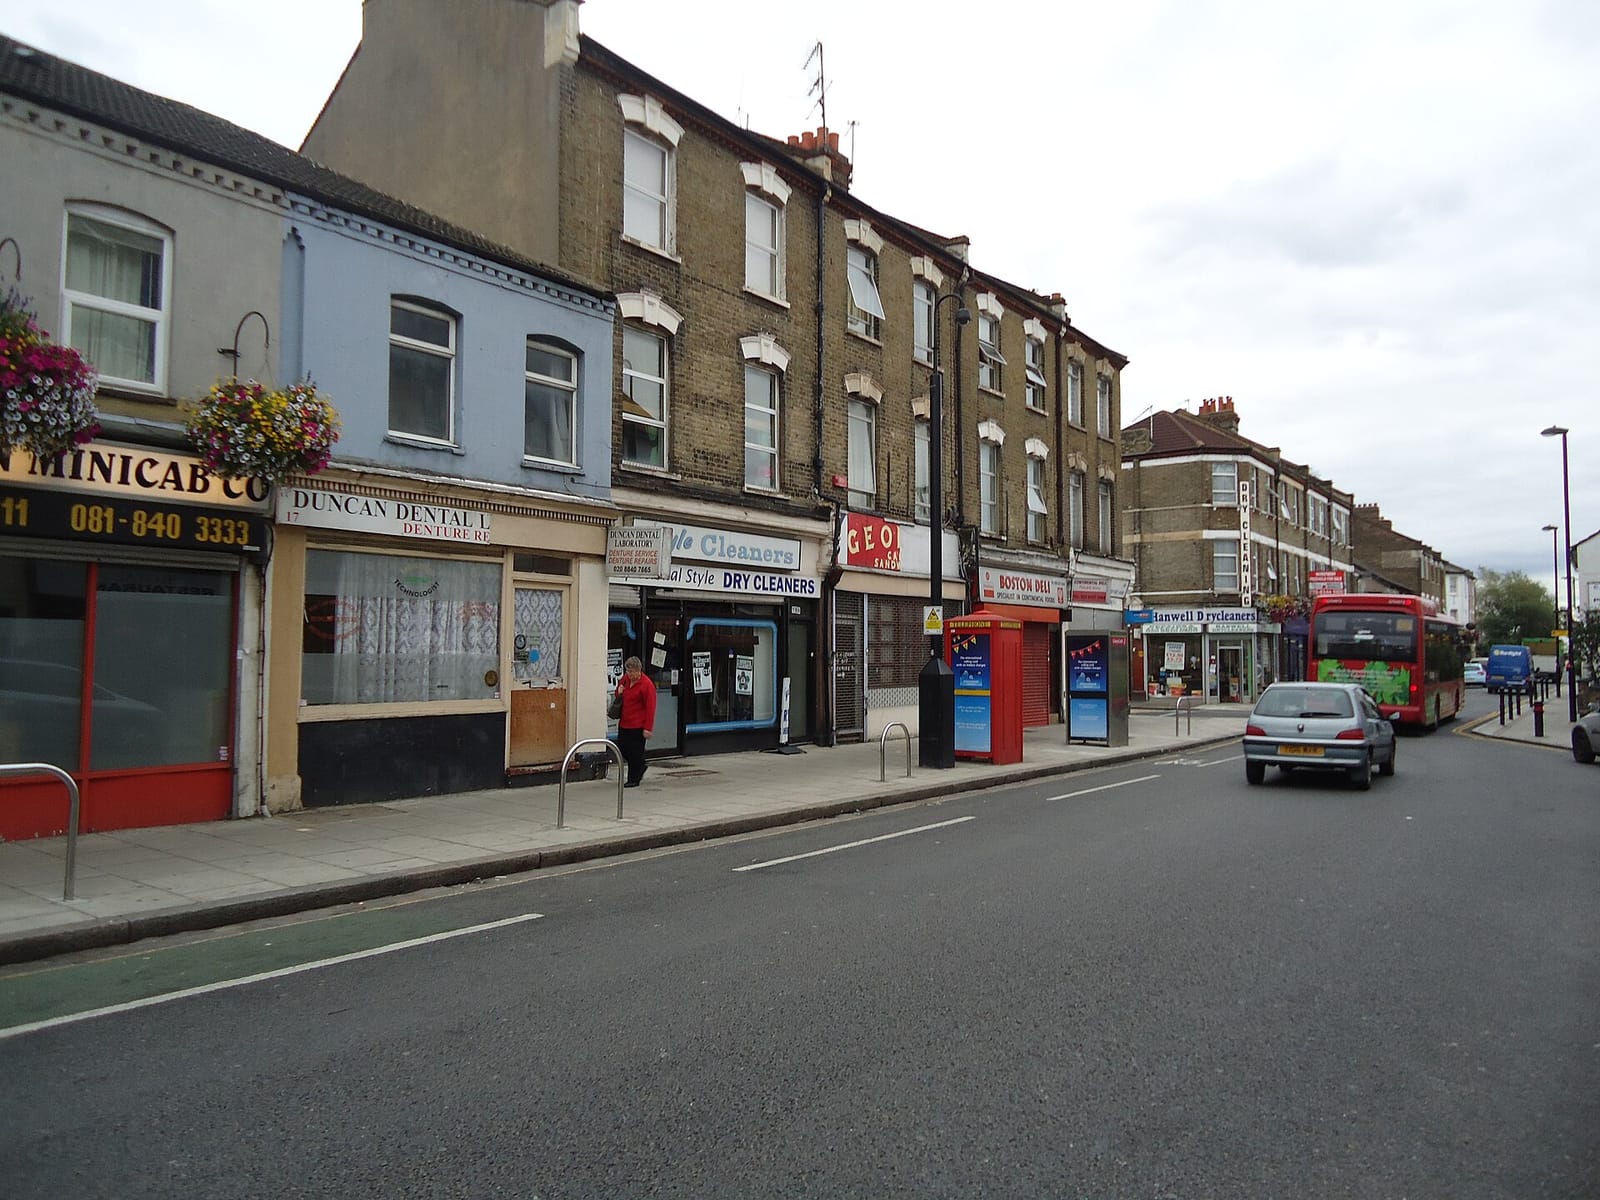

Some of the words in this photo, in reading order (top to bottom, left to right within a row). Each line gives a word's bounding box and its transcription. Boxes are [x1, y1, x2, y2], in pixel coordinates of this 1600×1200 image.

[28, 449, 211, 494] MINICAB
[287, 511, 300, 523] 17
[292, 490, 388, 518] DUNCAN
[396, 502, 473, 527] DENTAL
[194, 516, 249, 545] 3333
[403, 522, 470, 541] DENTURE
[610, 530, 636, 539] DUNCAN
[636, 531, 660, 540] DENTAL
[848, 524, 901, 554] GEO
[614, 539, 654, 548] LABORATORY
[634, 550, 657, 558] SERVICE
[700, 533, 794, 566] Cleaners
[1242, 520, 1250, 605] CLEANING
[394, 579, 440, 598] TECHNOLOGIST
[684, 568, 716, 588] Style
[722, 571, 751, 590] DRY
[753, 576, 816, 595] CLEANERS
[999, 575, 1033, 592] BOSTON
[1035, 580, 1051, 594] DELI
